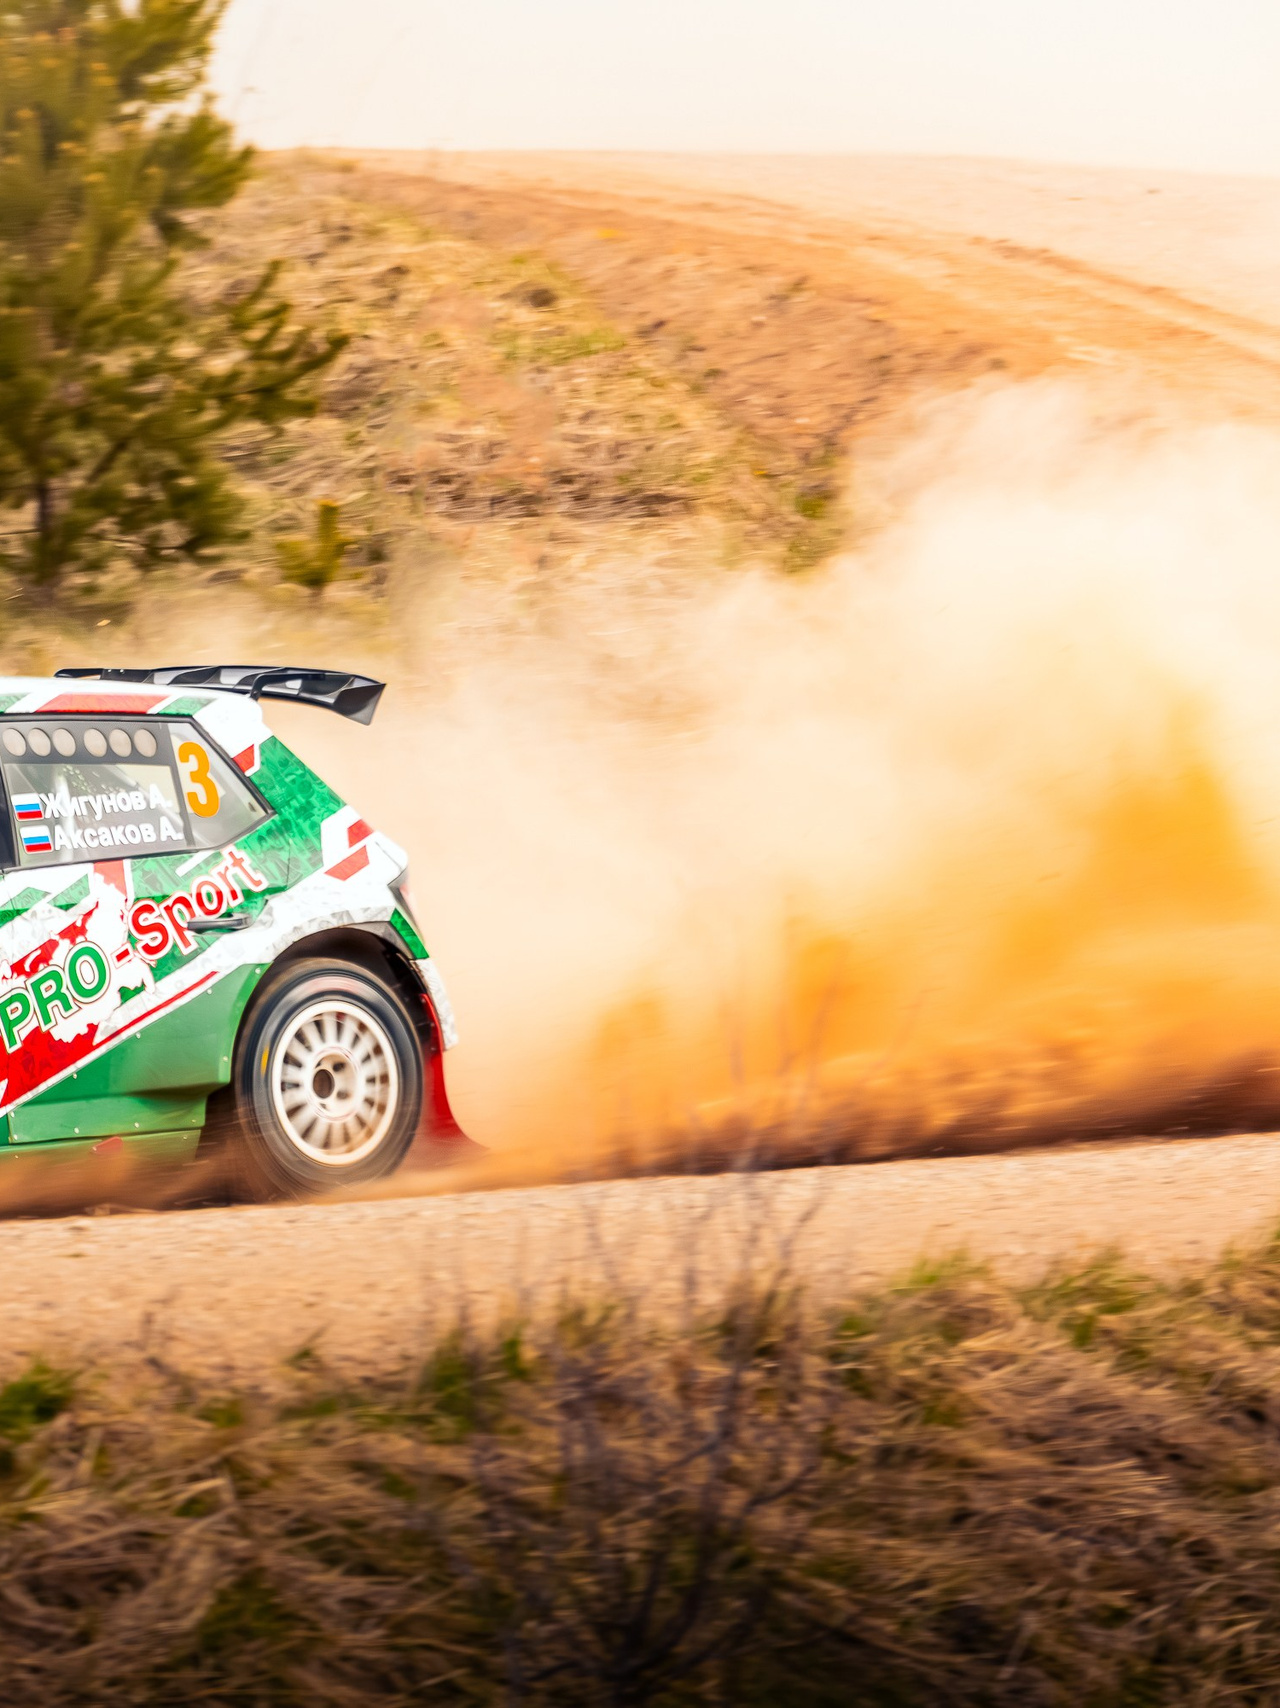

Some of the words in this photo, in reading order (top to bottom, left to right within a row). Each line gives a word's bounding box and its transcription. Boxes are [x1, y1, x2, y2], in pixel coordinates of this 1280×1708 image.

[178, 741, 220, 818] 3
[40, 789, 143, 820] Жигунов
[53, 821, 157, 851] Аксаков
